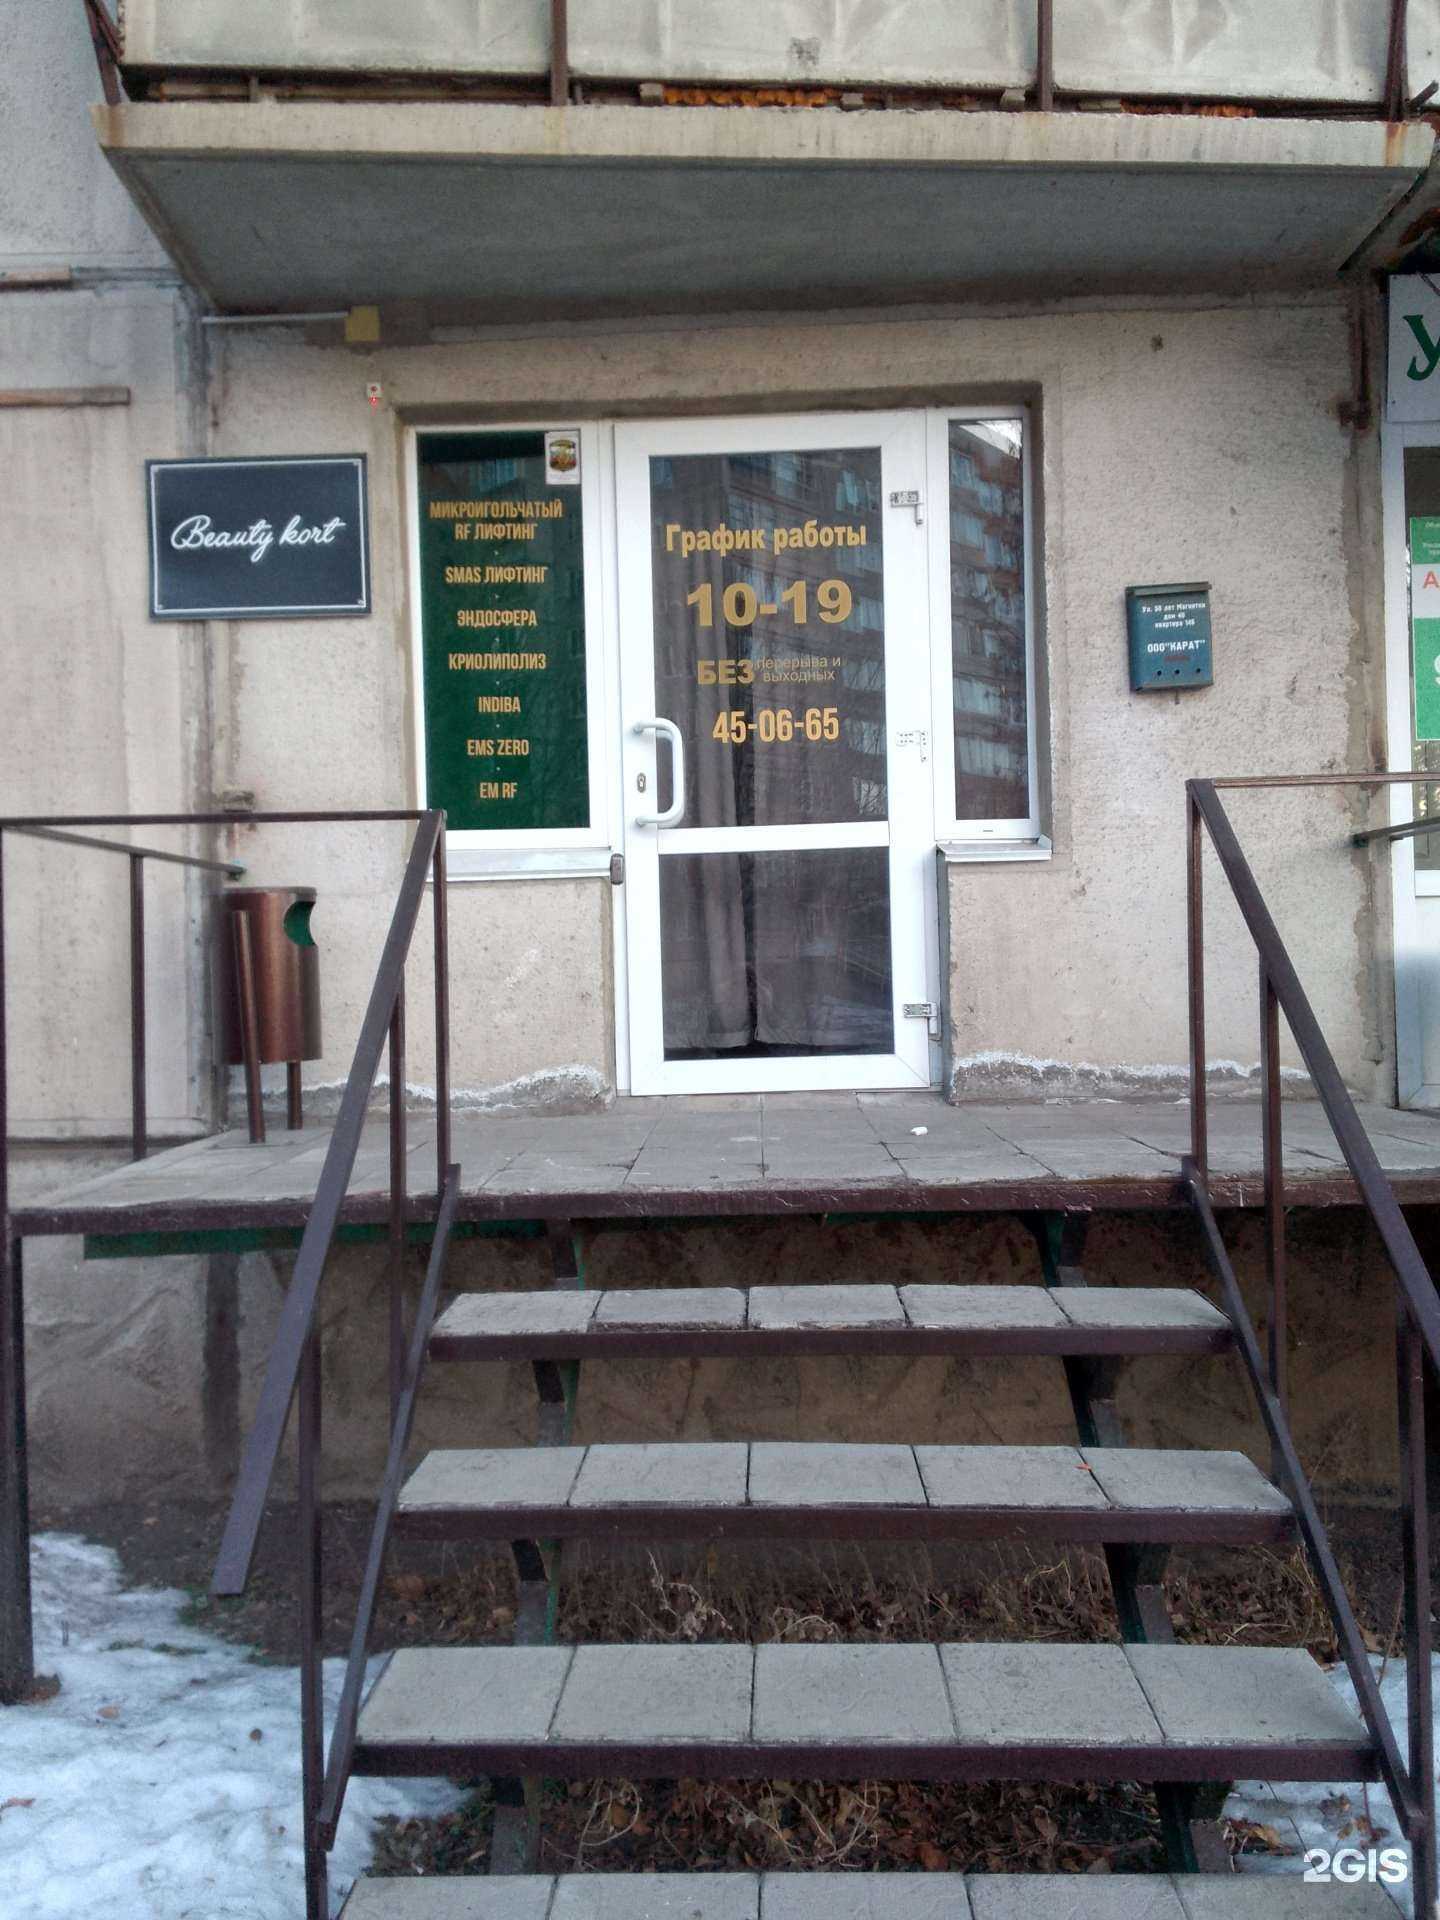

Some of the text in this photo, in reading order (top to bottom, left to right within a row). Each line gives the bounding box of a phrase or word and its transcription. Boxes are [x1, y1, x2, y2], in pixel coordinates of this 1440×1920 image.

[429, 499, 563, 519] МИКРОИГОЛЬЧАТЫЙ
[170, 514, 347, 563] Beauty kort
[455, 523, 538, 540] RF ЛИФТИНГ
[666, 519, 867, 558] График работы
[445, 566, 548, 584] SMAS ЛИФТИНГ
[687, 579, 852, 627] 10-19
[457, 611, 537, 628] ЭНДОСФЕРА
[449, 653, 547, 670] КРИОЛИПОЛИЗ
[756, 655, 841, 671] перерыва и
[697, 658, 754, 685] БЕЗ
[763, 669, 836, 683] выходных
[478, 696, 521, 713] INDIBA
[712, 706, 840, 744] 45-06-65
[466, 739, 530, 756] EMS ZERO
[479, 782, 518, 799] EM RF
